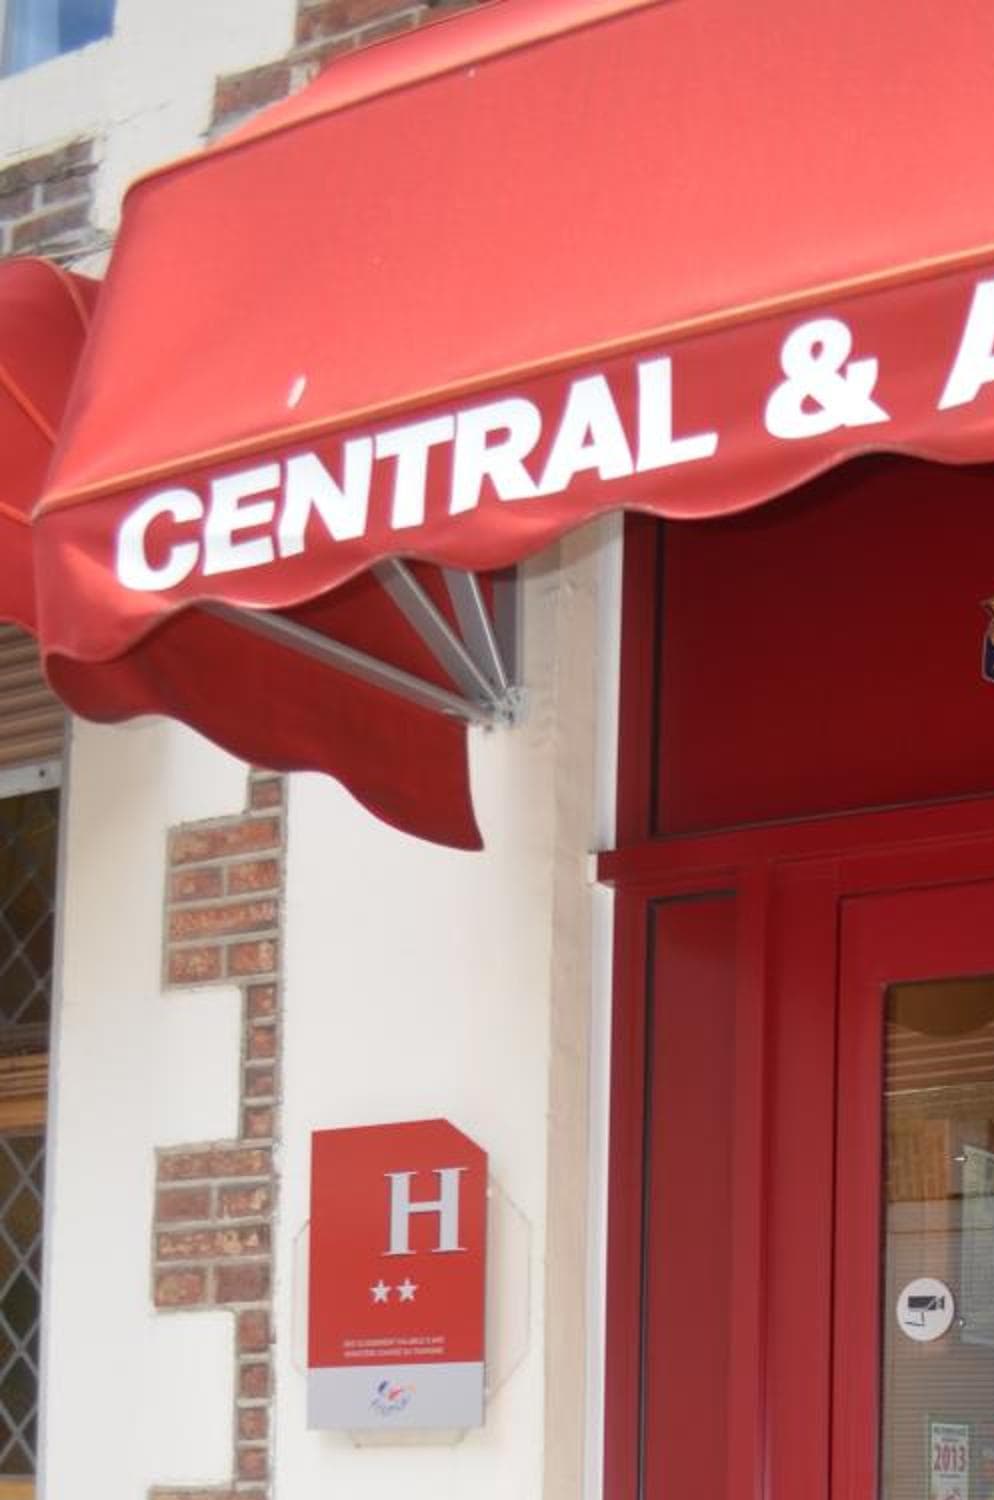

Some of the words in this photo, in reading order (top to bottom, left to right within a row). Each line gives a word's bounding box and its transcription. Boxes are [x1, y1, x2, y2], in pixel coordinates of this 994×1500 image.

[115, 356, 719, 592] CENTRAL
[764, 317, 890, 440] &
[382, 1166, 469, 1256] H
[933, 1441, 967, 1473] 2013
